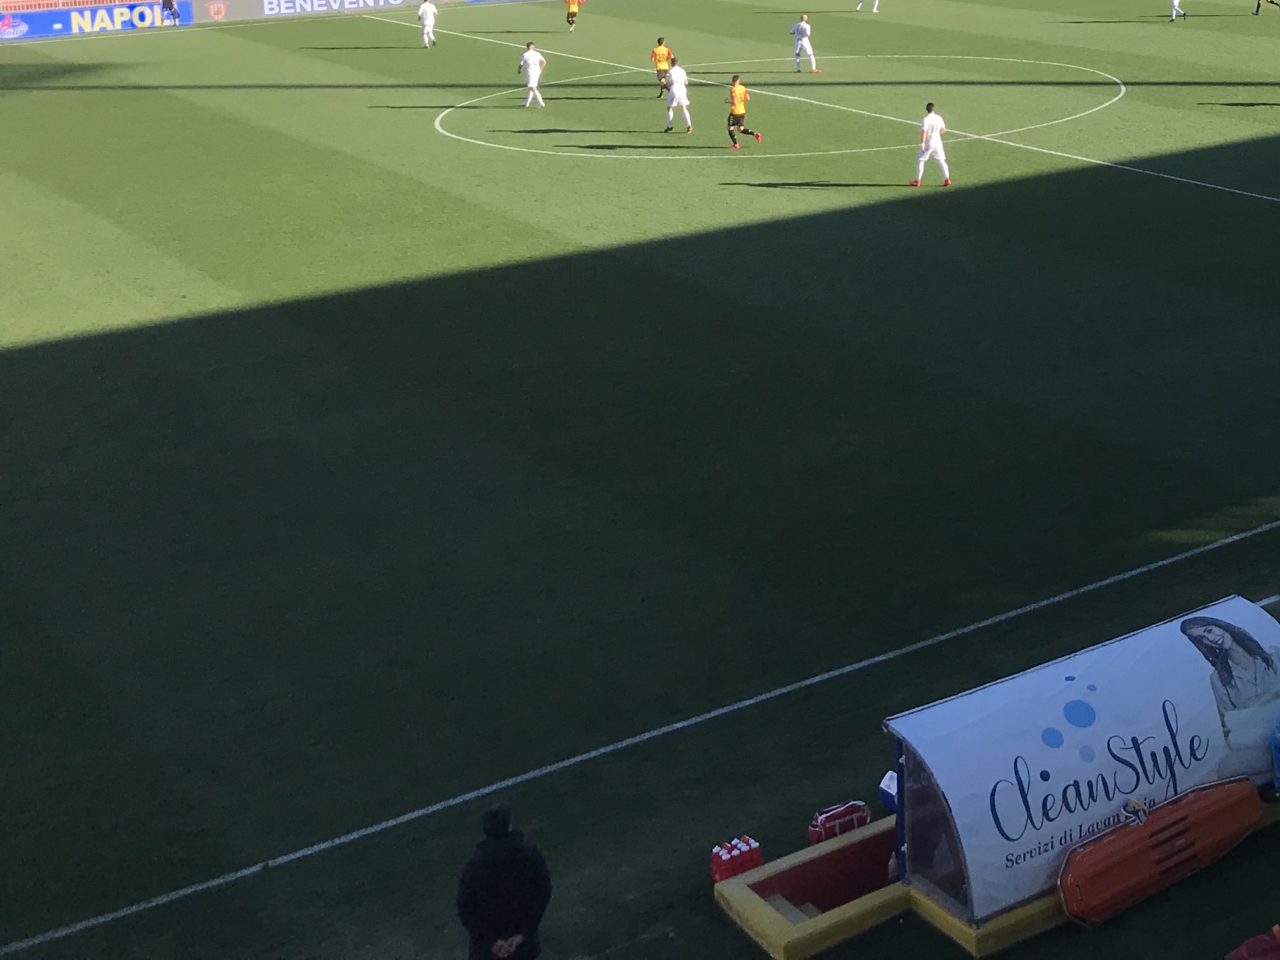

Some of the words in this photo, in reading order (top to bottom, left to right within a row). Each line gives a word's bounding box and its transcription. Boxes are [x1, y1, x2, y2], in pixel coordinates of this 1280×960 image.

[70, 5, 174, 33] NAPOL
[989, 699, 1210, 842] CleanStyle
[1005, 836, 1055, 868] Servizi
[1059, 829, 1073, 846] di
